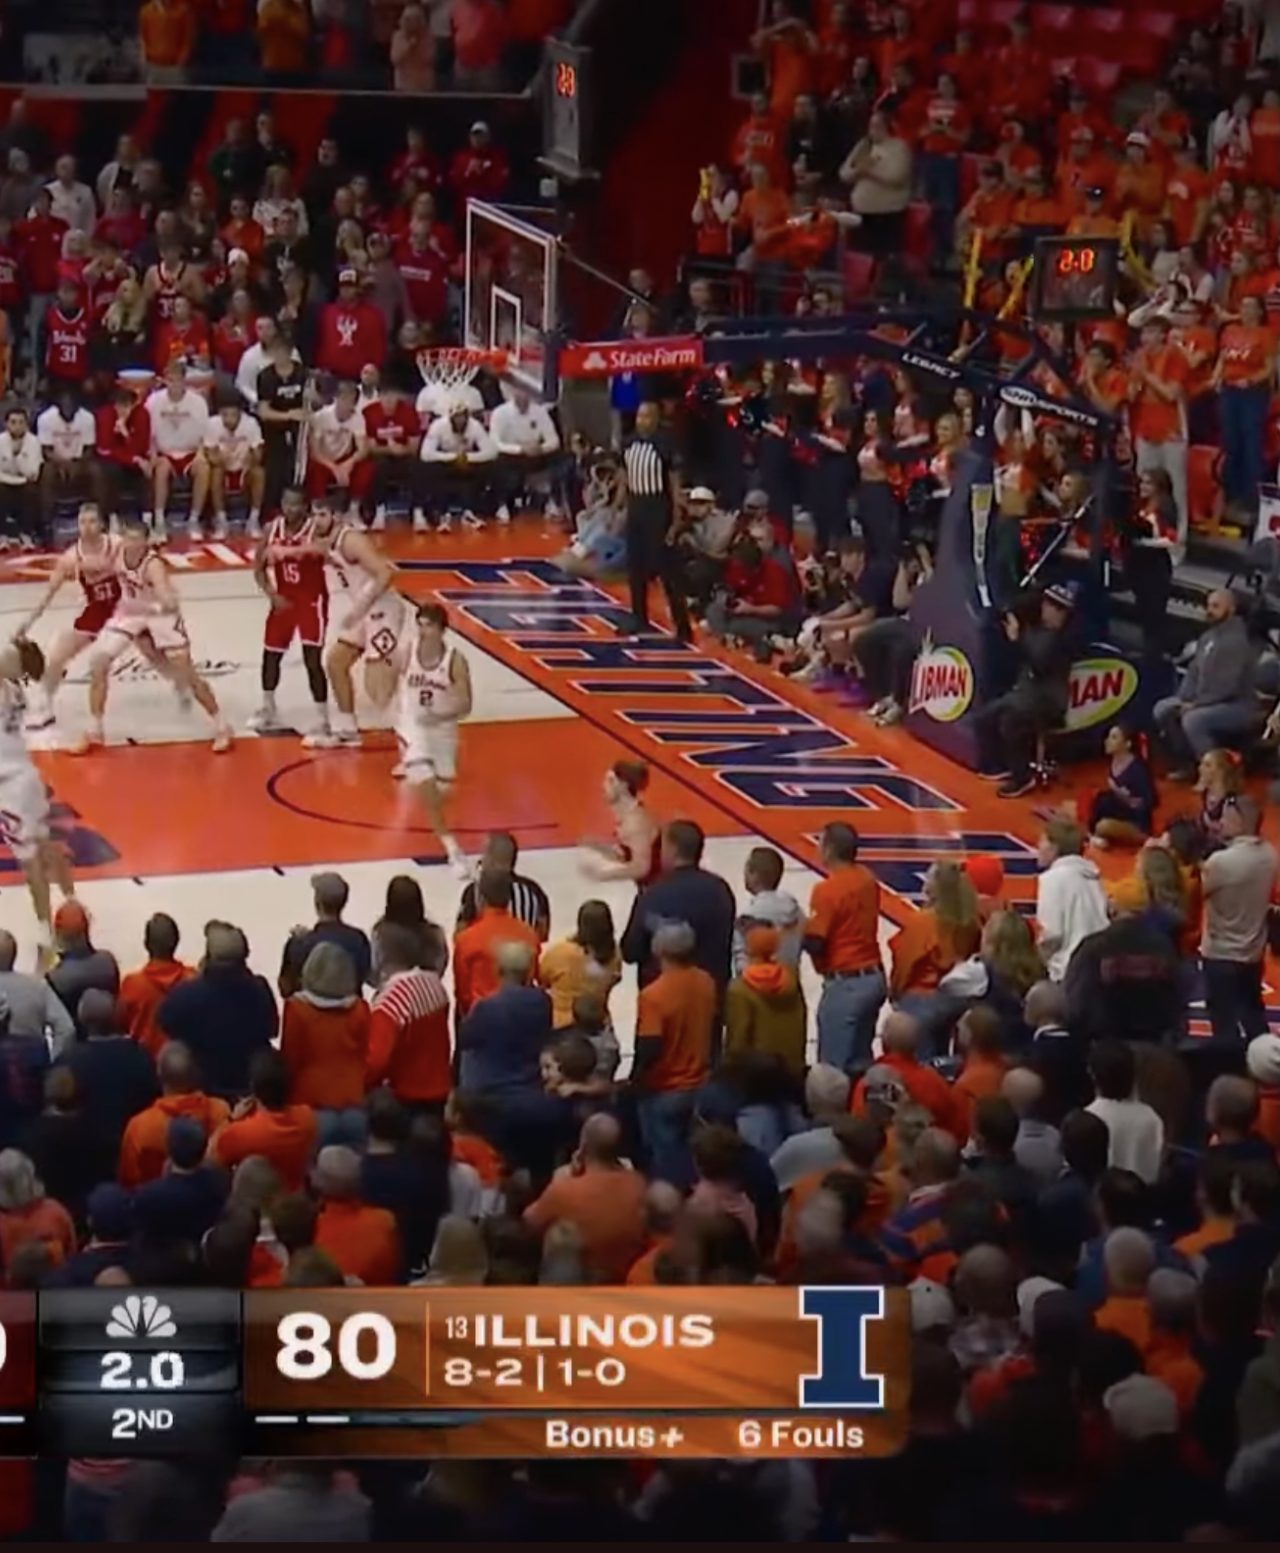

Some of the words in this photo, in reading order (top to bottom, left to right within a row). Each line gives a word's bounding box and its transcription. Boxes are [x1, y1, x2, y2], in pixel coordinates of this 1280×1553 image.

[60, 345, 77, 363] 31
[901, 352, 961, 379] LEGACY
[282, 562, 301, 584] 15
[910, 660, 968, 709] LIBMAN
